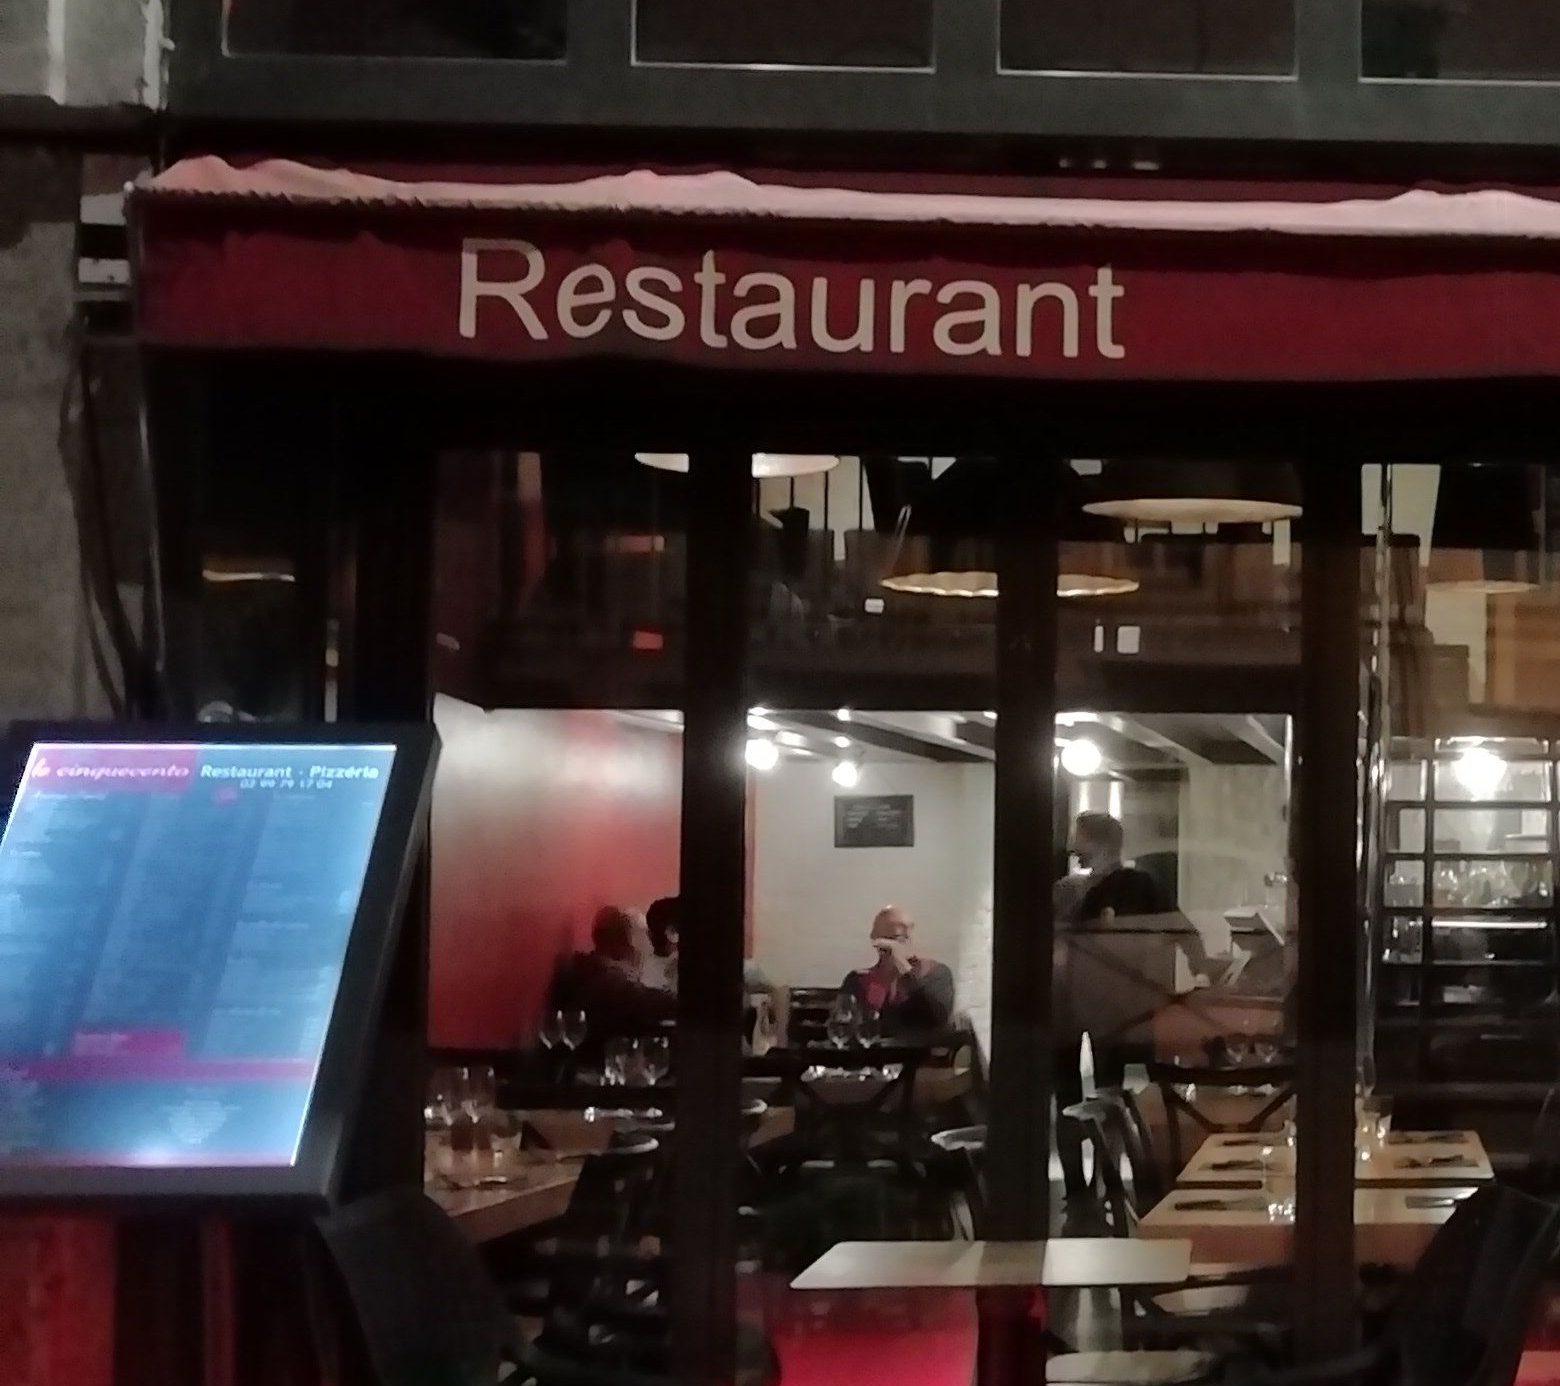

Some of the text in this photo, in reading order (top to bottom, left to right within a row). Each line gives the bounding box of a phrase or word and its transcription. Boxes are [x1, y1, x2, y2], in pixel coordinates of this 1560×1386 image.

[458, 237, 1126, 360] Restaurant
[200, 764, 293, 779] Restaurant
[308, 764, 380, 780] Pizzéria
